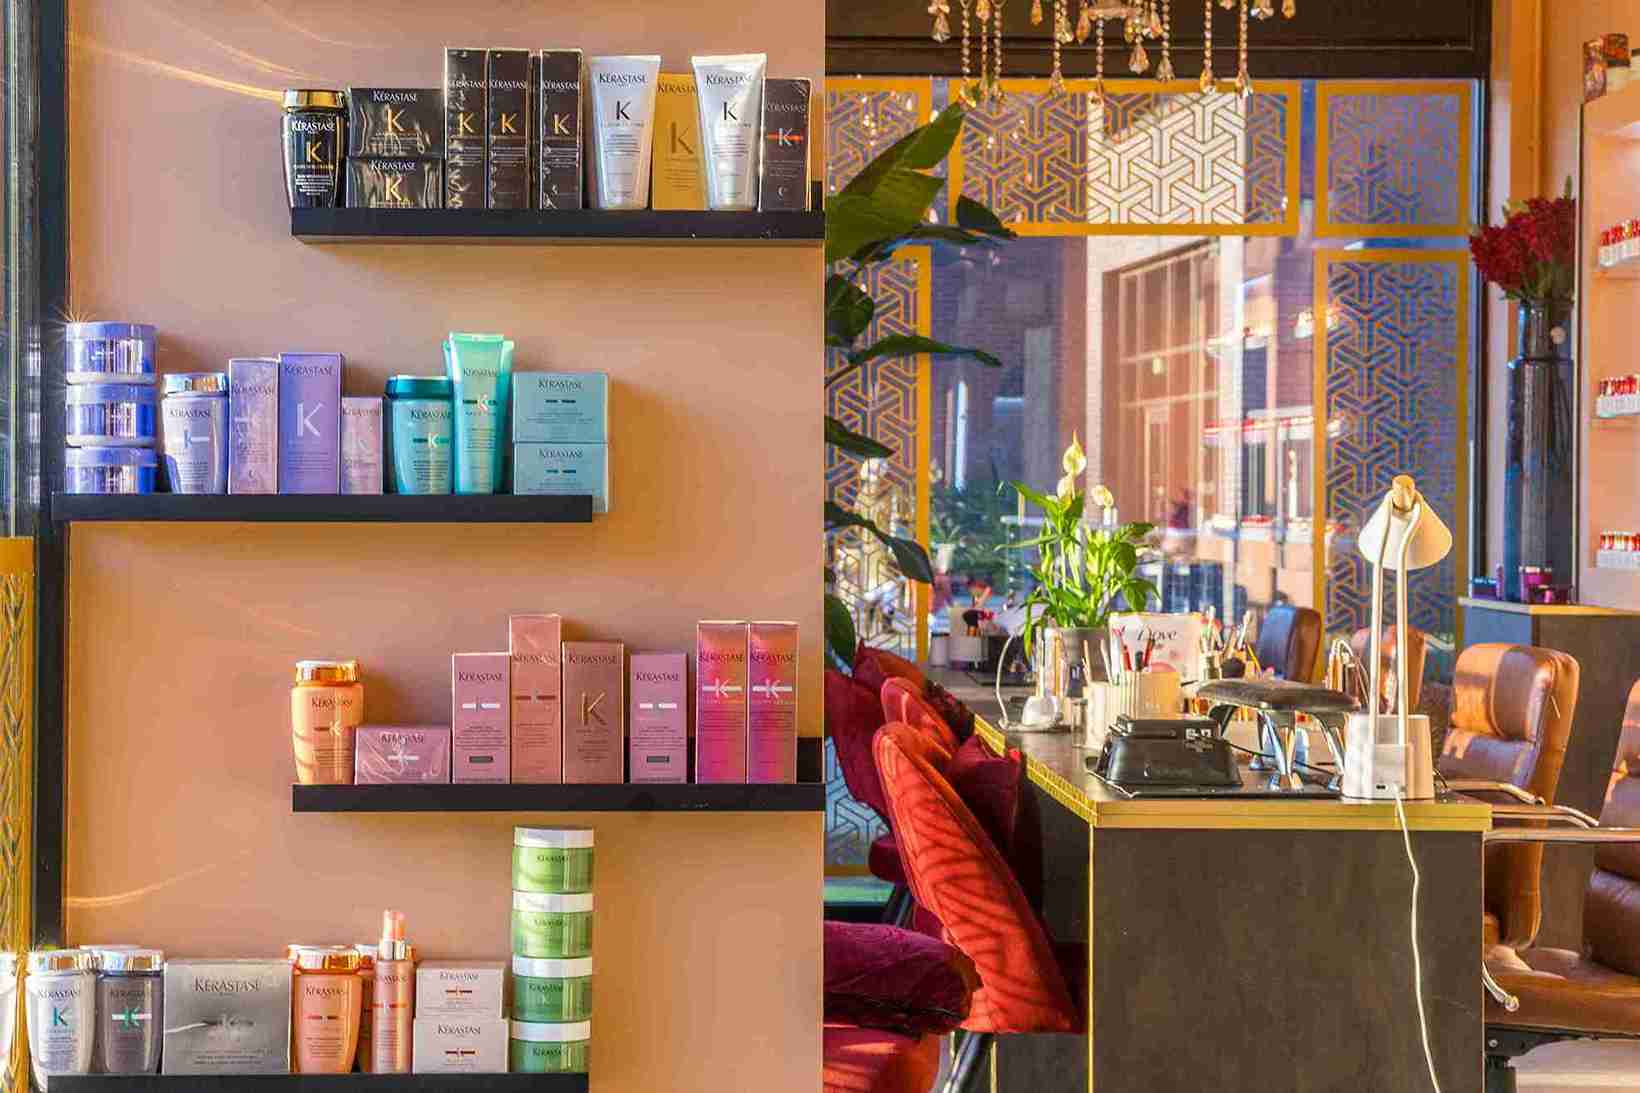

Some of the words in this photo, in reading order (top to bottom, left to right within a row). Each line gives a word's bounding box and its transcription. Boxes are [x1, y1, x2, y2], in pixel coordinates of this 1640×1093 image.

[387, 108, 405, 132] K
[615, 100, 632, 120] K
[723, 102, 738, 121] K
[458, 112, 475, 134] K
[502, 112, 518, 134] K
[553, 113, 570, 134] K
[671, 122, 695, 154] K
[779, 127, 793, 146] K
[306, 141, 322, 162] K
[385, 175, 402, 201] K
[477, 393, 489, 411] K
[296, 402, 325, 437] K
[427, 432, 438, 448] K
[714, 677, 729, 699] K
[764, 678, 780, 699] K
[581, 690, 607, 726] K
[53, 1007, 69, 1027] K
[123, 1007, 141, 1031] K
